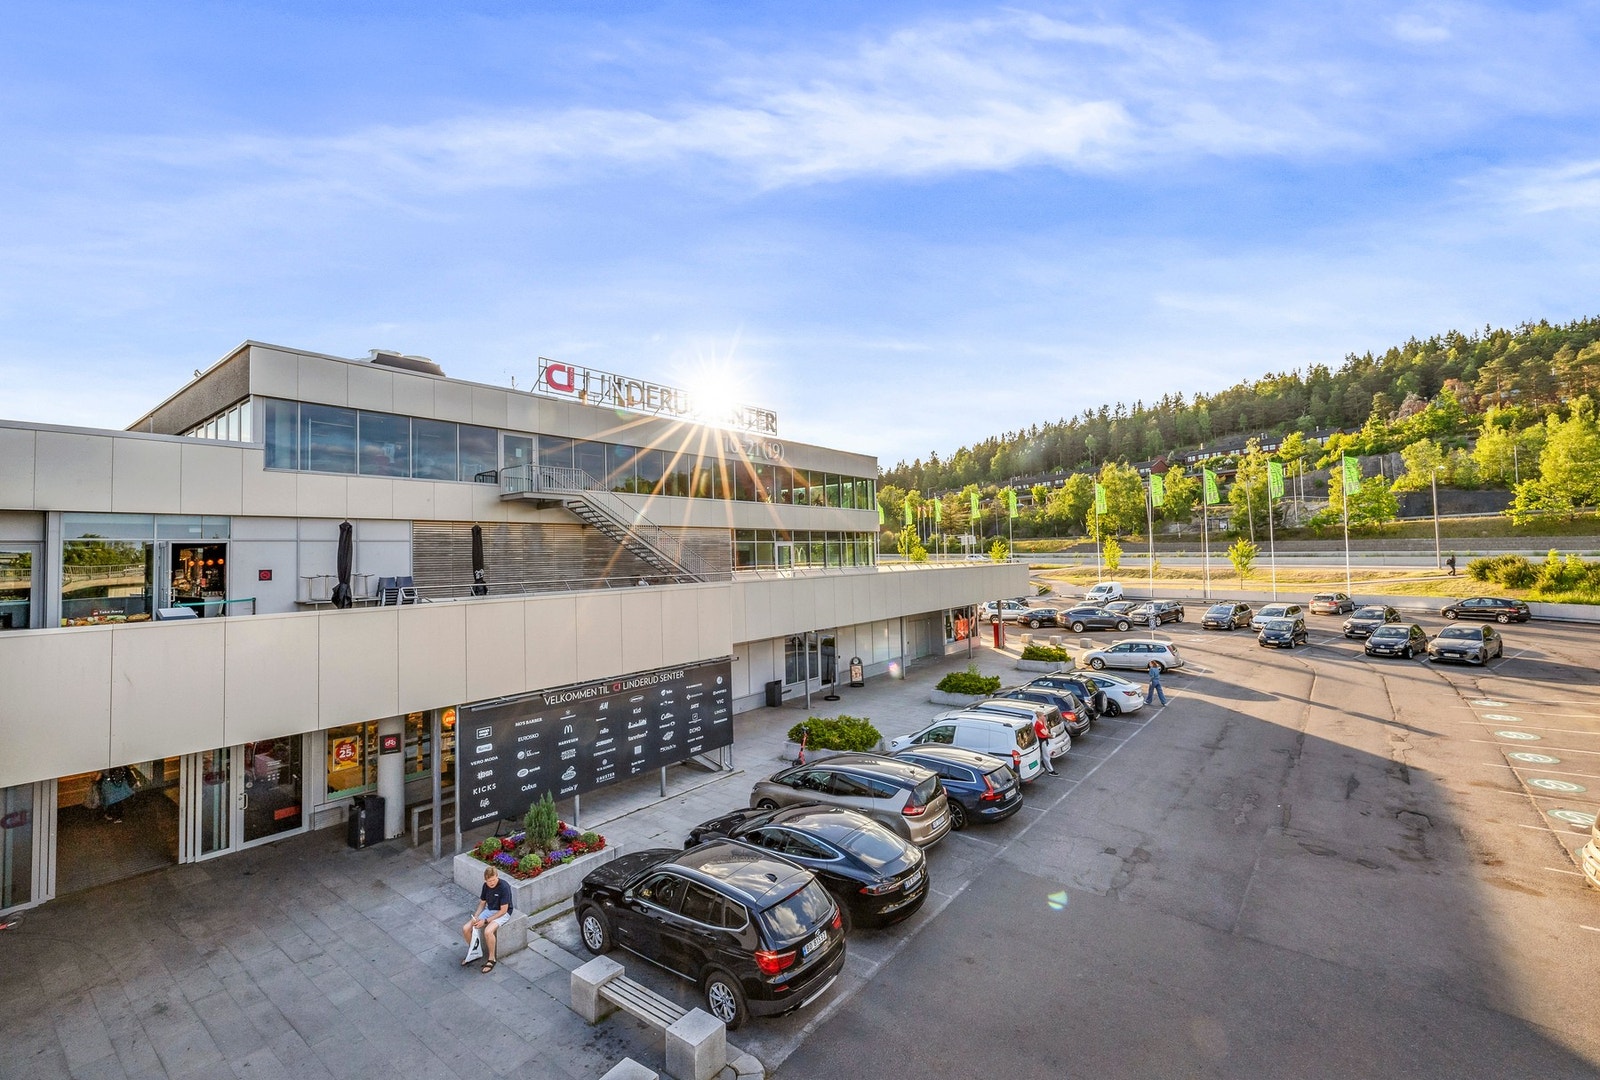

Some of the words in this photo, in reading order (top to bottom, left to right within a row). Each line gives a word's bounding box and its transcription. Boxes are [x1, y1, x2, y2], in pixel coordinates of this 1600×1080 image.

[586, 371, 698, 415] LINDERU
[544, 688, 598, 705] VELKOMMEN
[599, 686, 610, 695] TIL
[623, 676, 659, 690] LINDERUD
[660, 671, 684, 683] SENTER
[518, 733, 540, 742] EUROSKO
[473, 783, 497, 795] KICKS
